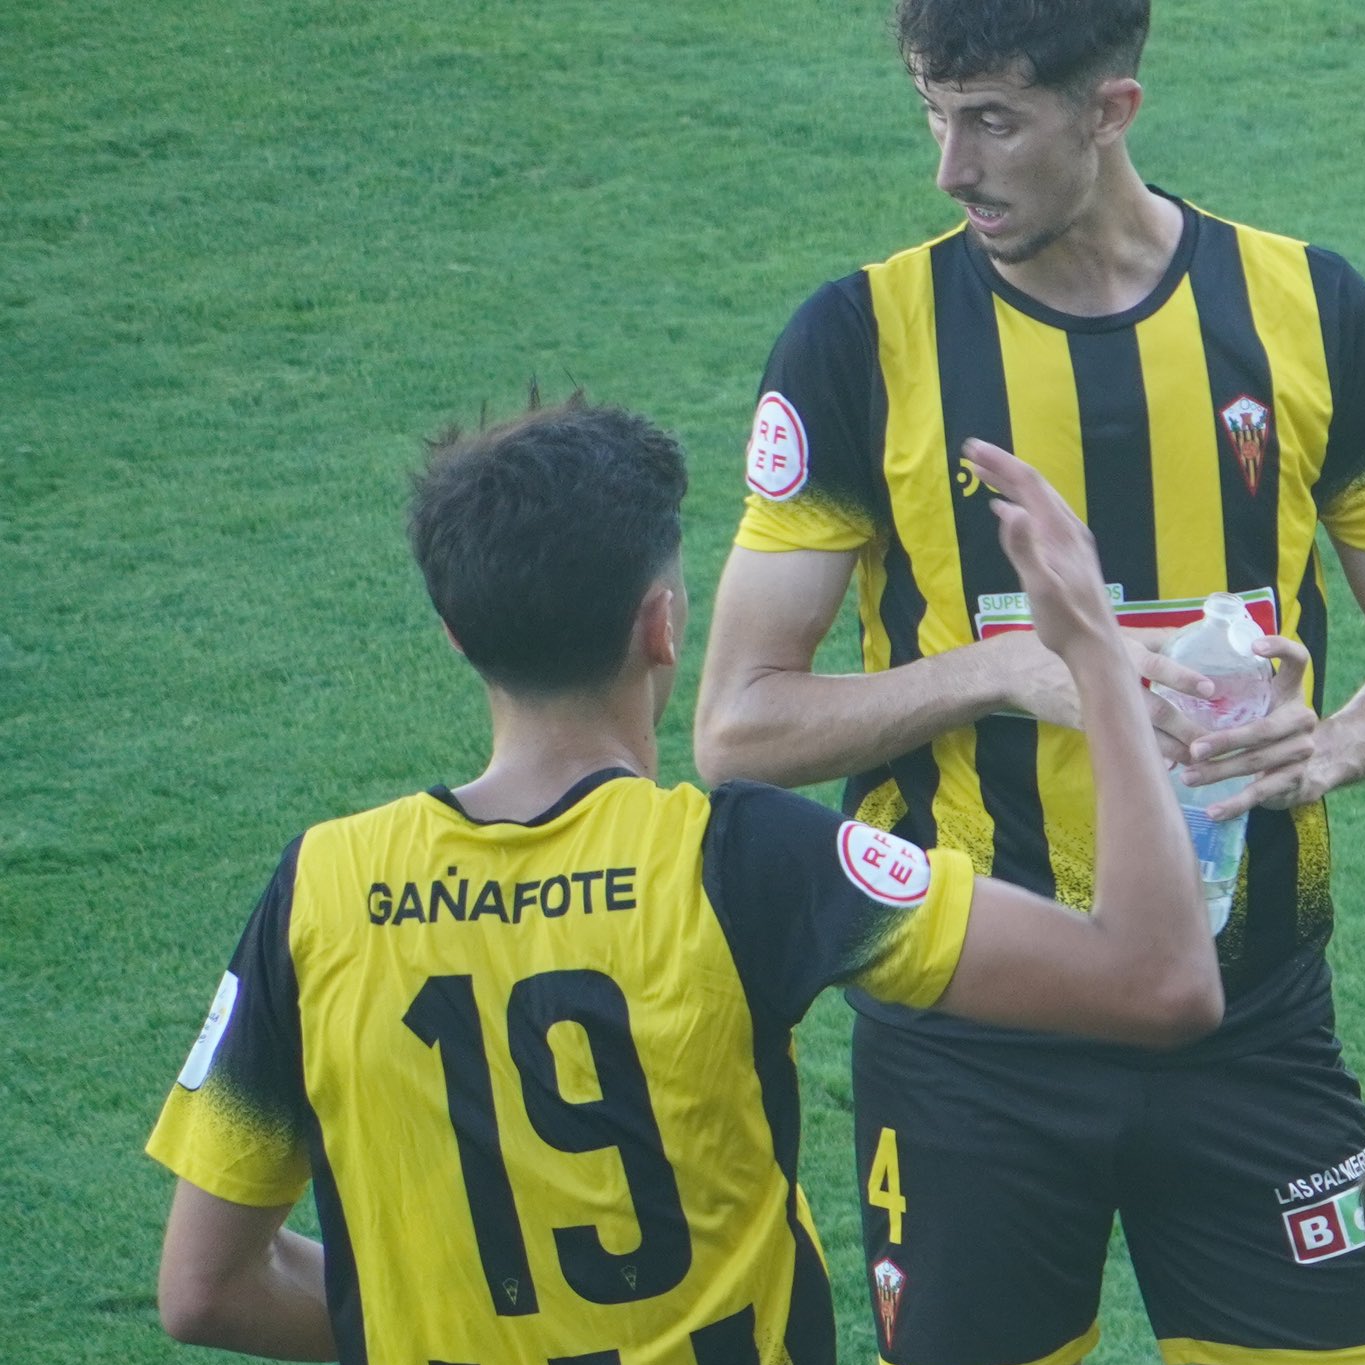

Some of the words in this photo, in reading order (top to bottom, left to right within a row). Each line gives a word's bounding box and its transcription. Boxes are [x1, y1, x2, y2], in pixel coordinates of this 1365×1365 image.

[401, 968, 692, 1317] 19
[868, 1128, 906, 1244] 4
[1274, 1179, 1315, 1205] LAS
